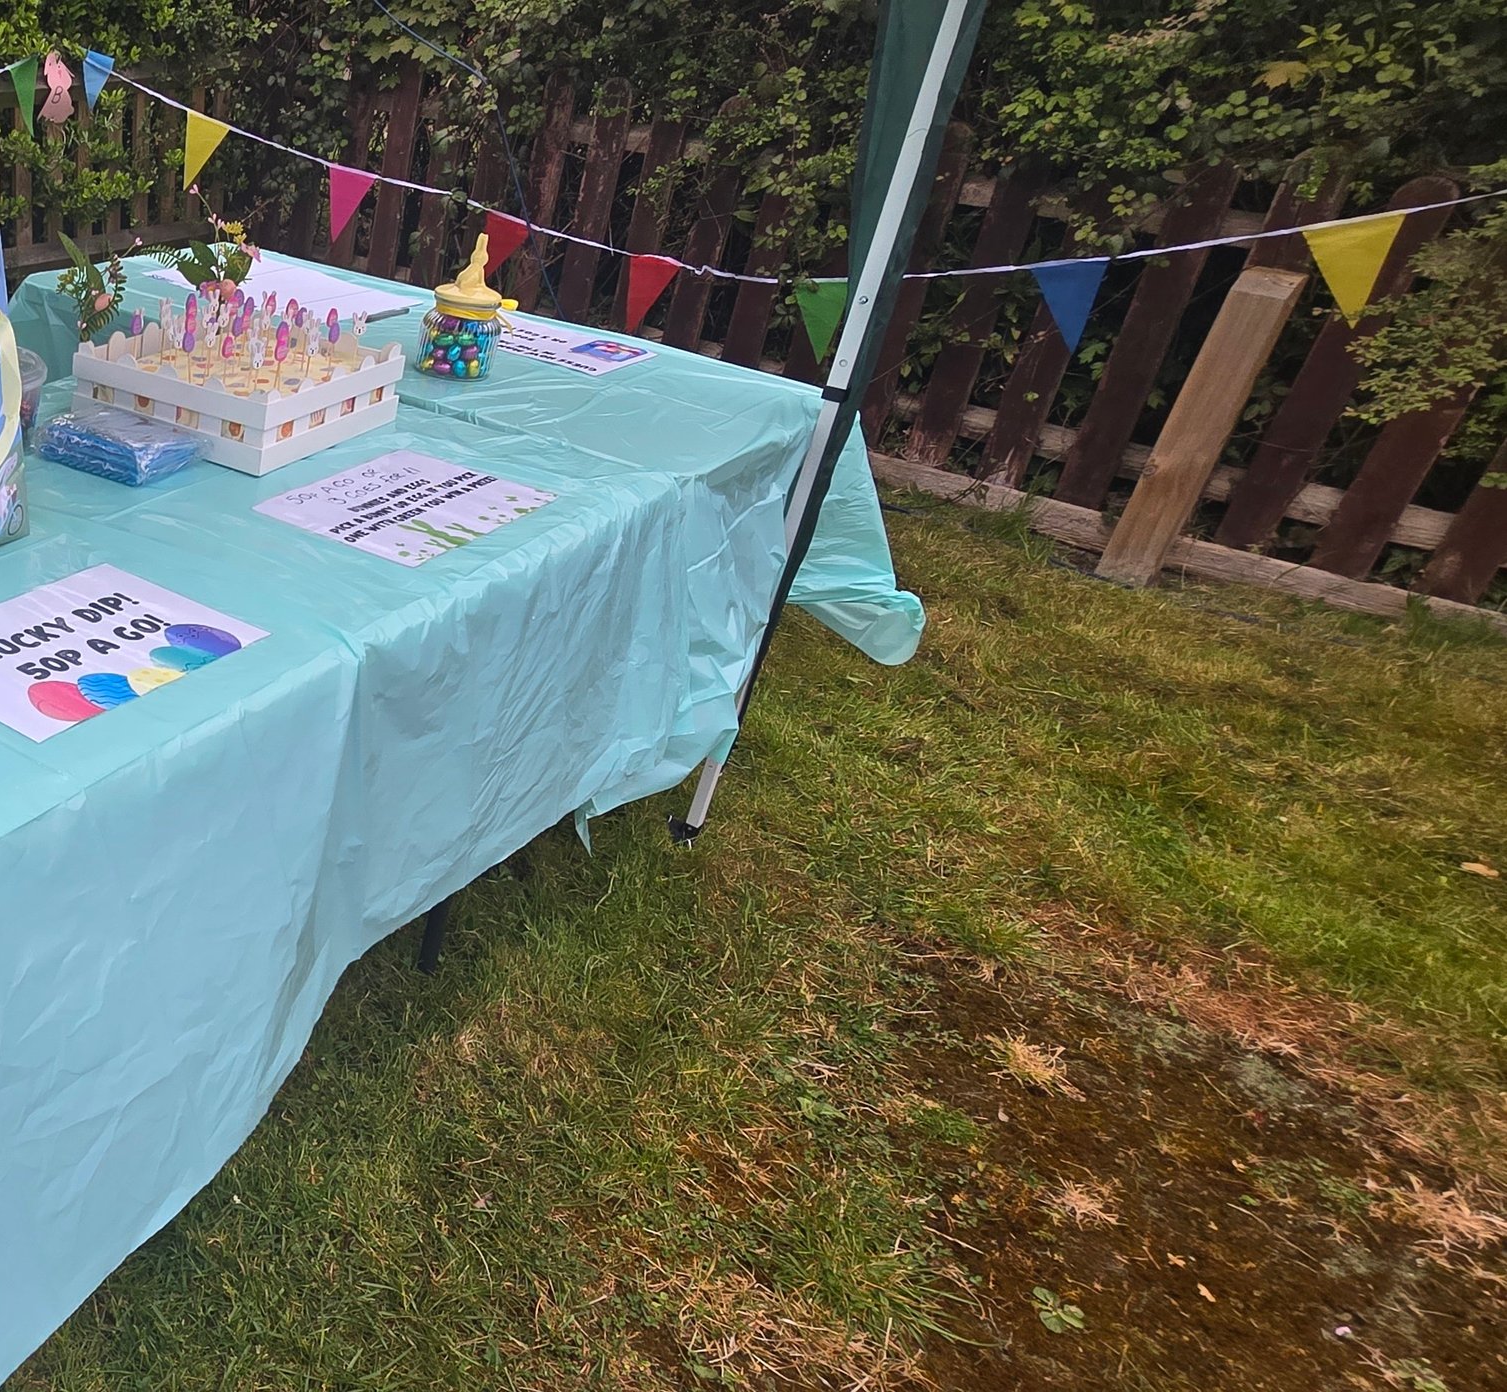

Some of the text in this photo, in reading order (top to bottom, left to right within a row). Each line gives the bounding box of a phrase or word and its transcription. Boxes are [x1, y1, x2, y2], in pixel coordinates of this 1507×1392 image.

[557, 358, 597, 372] GUESS
[320, 486, 335, 495] A
[332, 478, 355, 489] GO
[328, 521, 357, 535] PICK
[361, 505, 397, 521] BUNNY
[393, 500, 412, 509] OR
[425, 486, 439, 495] IF
[434, 478, 459, 491] YOU
[453, 471, 478, 483] PICK
[344, 482, 382, 499] GOES
[347, 478, 432, 513] BUNNIES AND EGGS
[344, 528, 370, 544] ONE
[367, 517, 398, 533] WITH
[393, 507, 428, 523] GREEN
[421, 497, 446, 510] YOU
[440, 488, 465, 501] WIN
[72, 592, 140, 624] DIP!
[16, 613, 172, 681] 50P A GO!
